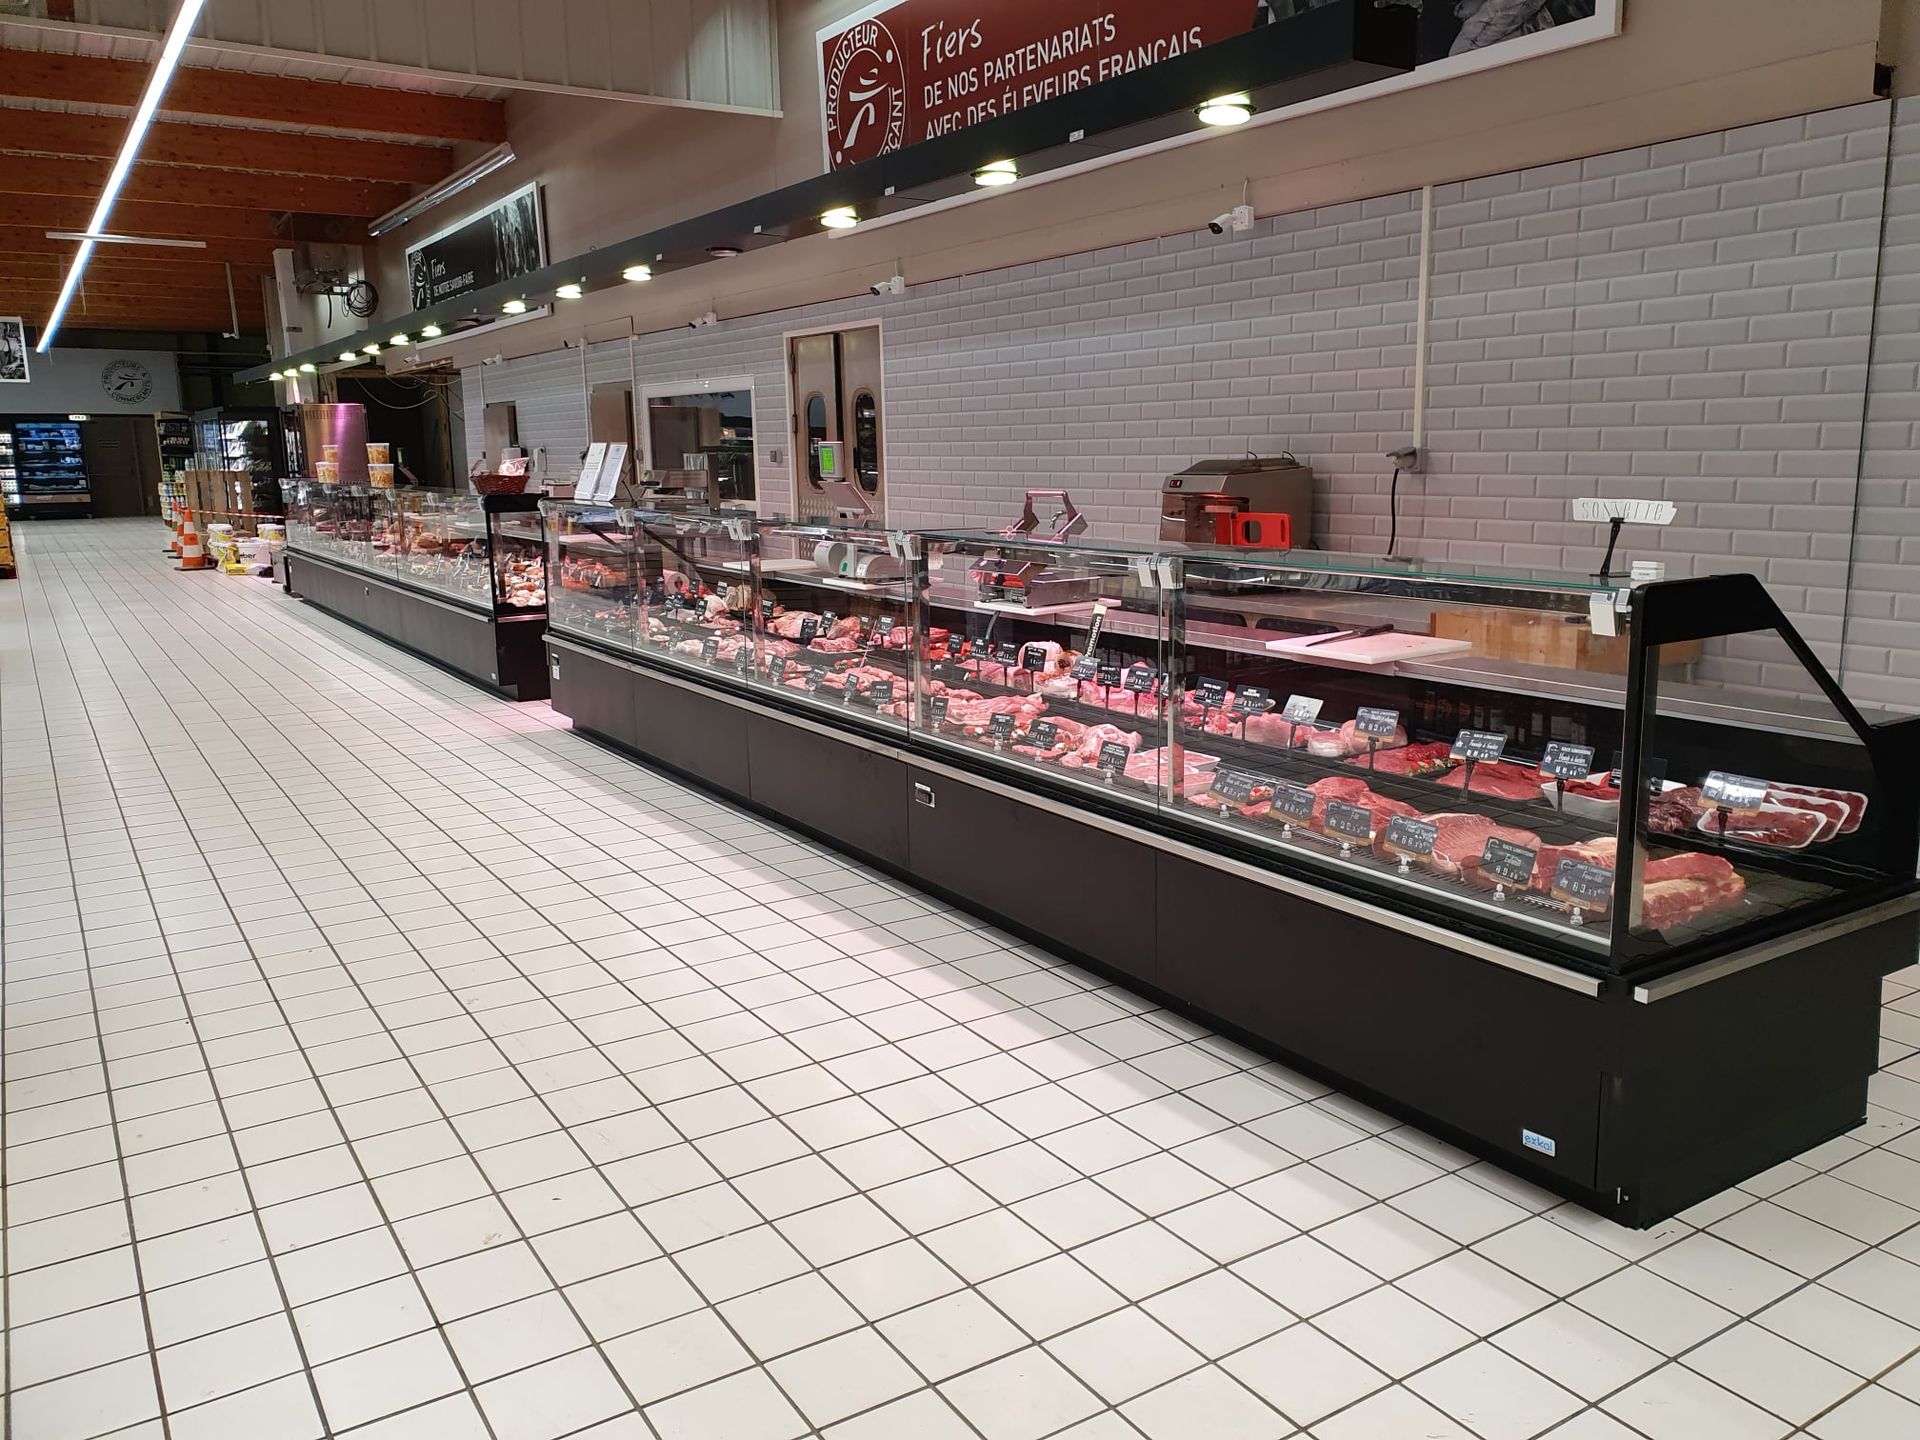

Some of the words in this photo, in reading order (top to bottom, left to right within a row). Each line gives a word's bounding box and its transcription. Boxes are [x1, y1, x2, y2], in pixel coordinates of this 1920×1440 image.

[921, 19, 982, 71] Fiers
[924, 81, 943, 109] DE
[948, 67, 979, 100] NOS
[984, 13, 1116, 87] PARTENARIATS
[827, 24, 878, 131] PRODUCTEUR
[926, 111, 962, 140] AVEC
[967, 99, 996, 126] DES
[1524, 1134, 1553, 1152] exkal
